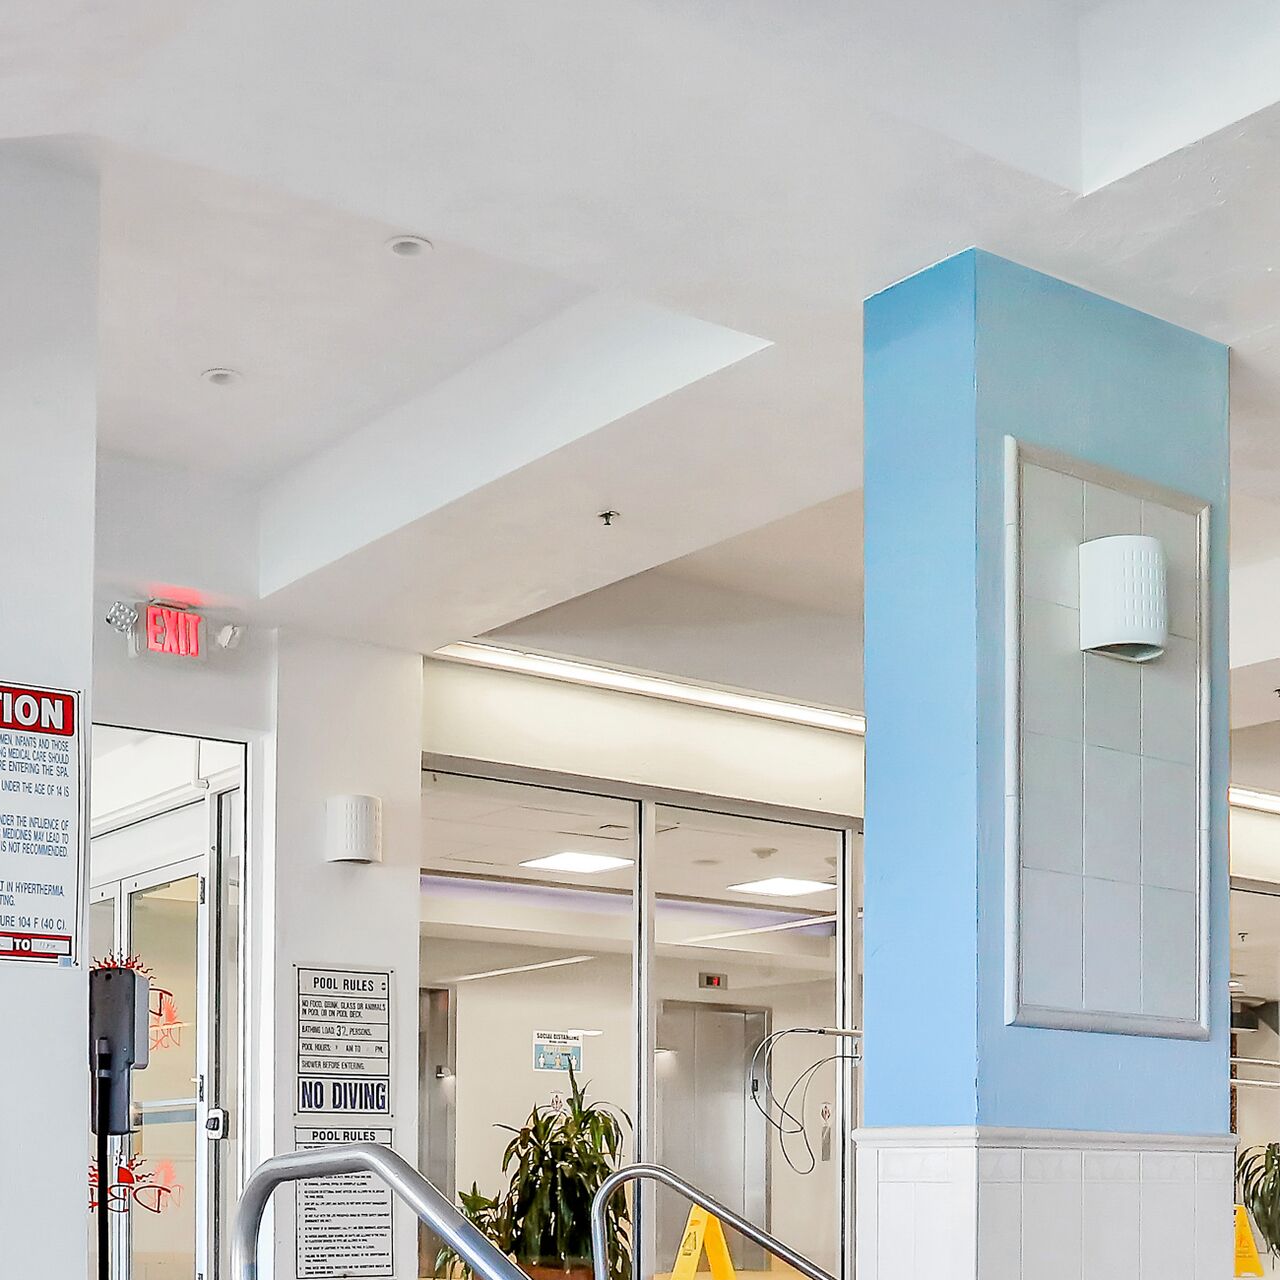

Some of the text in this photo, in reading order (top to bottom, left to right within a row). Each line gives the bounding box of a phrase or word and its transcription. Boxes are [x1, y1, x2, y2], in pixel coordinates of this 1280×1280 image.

[146, 605, 202, 657] EXIT
[15, 735, 37, 748] INFANTS
[38, 738, 49, 750] AND
[51, 740, 69, 752] THOSE
[8, 747, 31, 760] MEDICAL
[32, 750, 46, 762] CARE
[48, 751, 69, 765] SHOULD
[8, 760, 40, 774] ENTERING
[42, 764, 54, 776] THE
[1, 779, 21, 792] UNDER
[22, 781, 33, 794] THE
[34, 783, 45, 795] AGE
[46, 784, 55, 795] OF
[63, 786, 70, 798] IS
[16, 815, 27, 828] THE
[28, 816, 59, 830] INFLUENCE
[61, 819, 69, 831] OF
[2, 827, 32, 841] MEDICINES
[33, 830, 45, 842] MAY
[45, 831, 60, 844] LEAD
[61, 832, 69, 845] TO
[0, 840, 7, 852] IS
[8, 840, 21, 853] NOT
[6, 881, 14, 893] IN
[18, 916, 31, 928] 104
[33, 917, 39, 928] F
[40, 918, 54, 930] (40
[13, 938, 31, 951] TO
[313, 976, 374, 992] POOL RULES
[301, 999, 309, 1007] NO
[340, 1001, 356, 1010] GLASS
[357, 1002, 364, 1010] OR
[365, 1003, 386, 1011] ANIMALS
[308, 1008, 319, 1016] POOL
[328, 1009, 336, 1017] ON
[336, 1010, 348, 1018] POOL
[301, 1025, 321, 1034] BATHING
[301, 1042, 313, 1051] POOL
[345, 1044, 353, 1053] AM
[354, 1045, 361, 1053] TO
[301, 1060, 321, 1069] SHOWER
[322, 1061, 340, 1069] BEFORE
[301, 1081, 386, 1110] NO DIVING
[312, 1131, 376, 1141] POOL RULES
